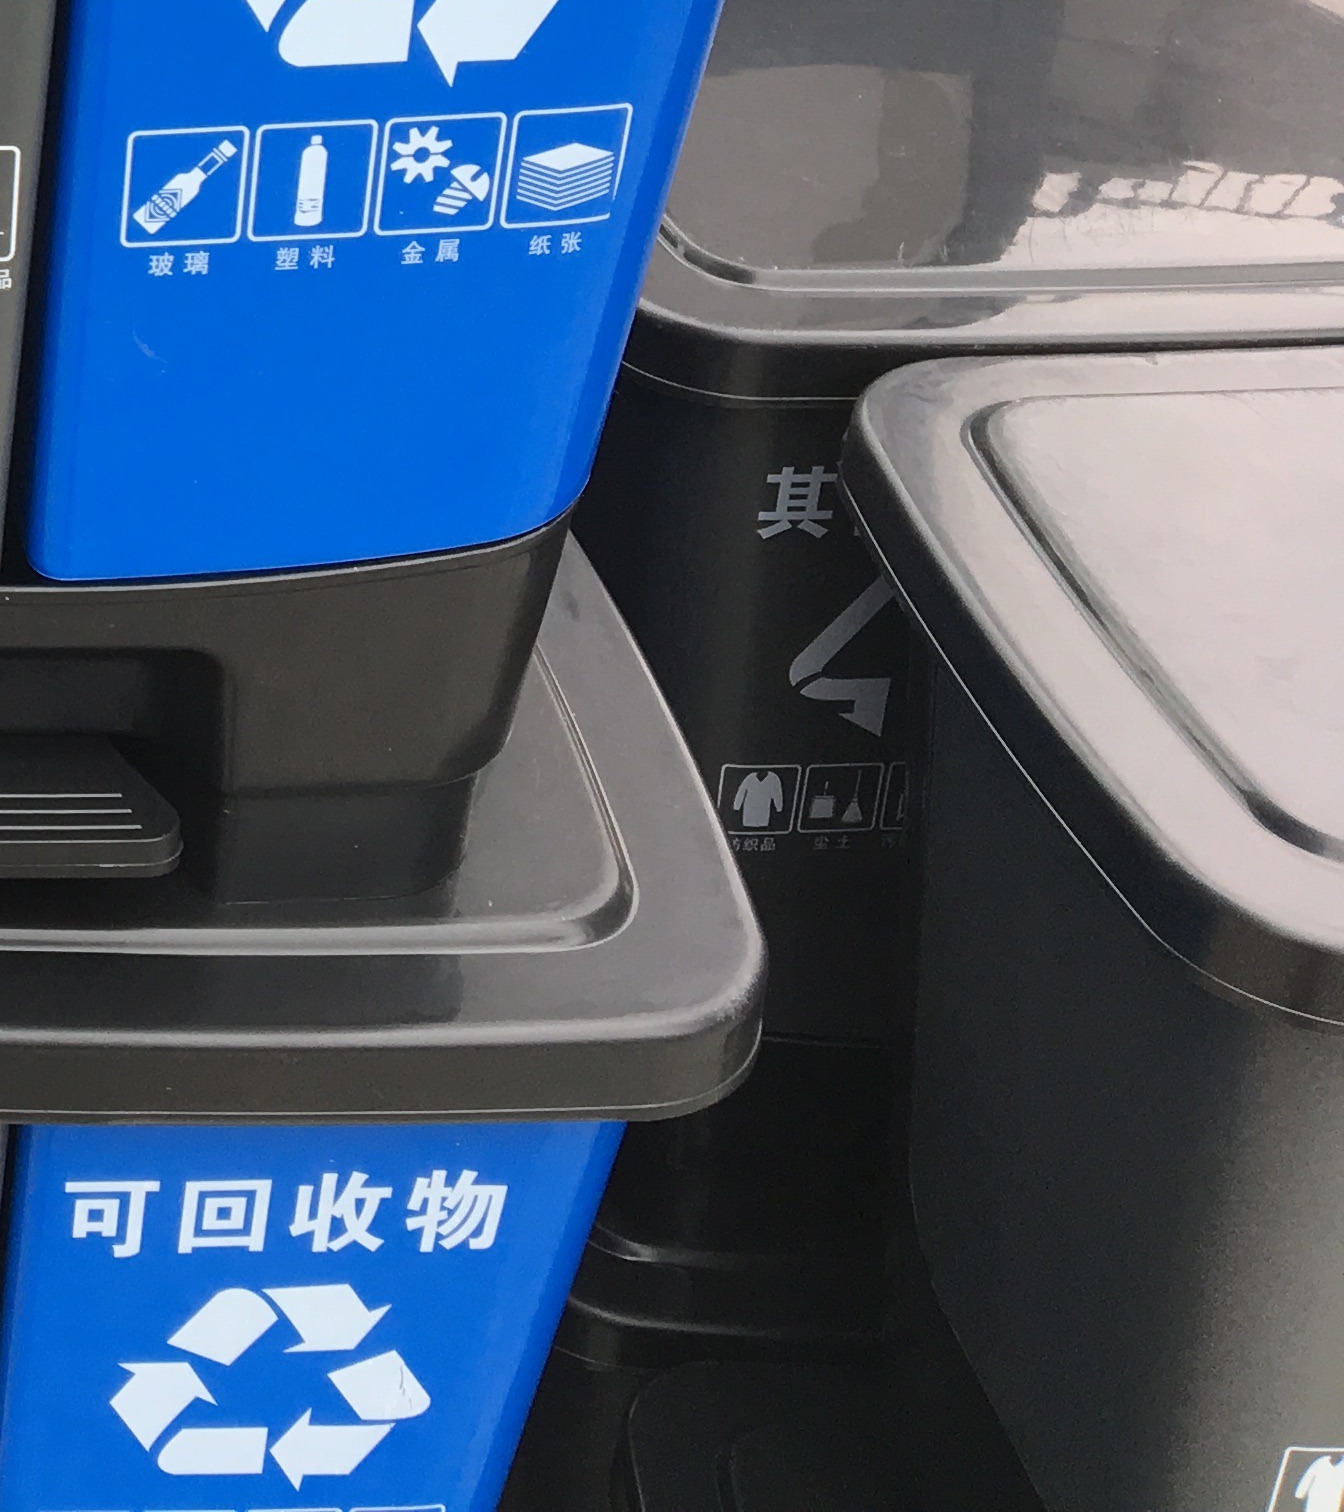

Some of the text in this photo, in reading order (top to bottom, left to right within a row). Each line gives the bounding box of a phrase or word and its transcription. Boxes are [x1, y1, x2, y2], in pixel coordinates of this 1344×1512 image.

[148, 231, 582, 277] 玻璃 塑料 金属 纸张
[756, 465, 860, 540] 其
[64, 1169, 509, 1258] 可回收物
